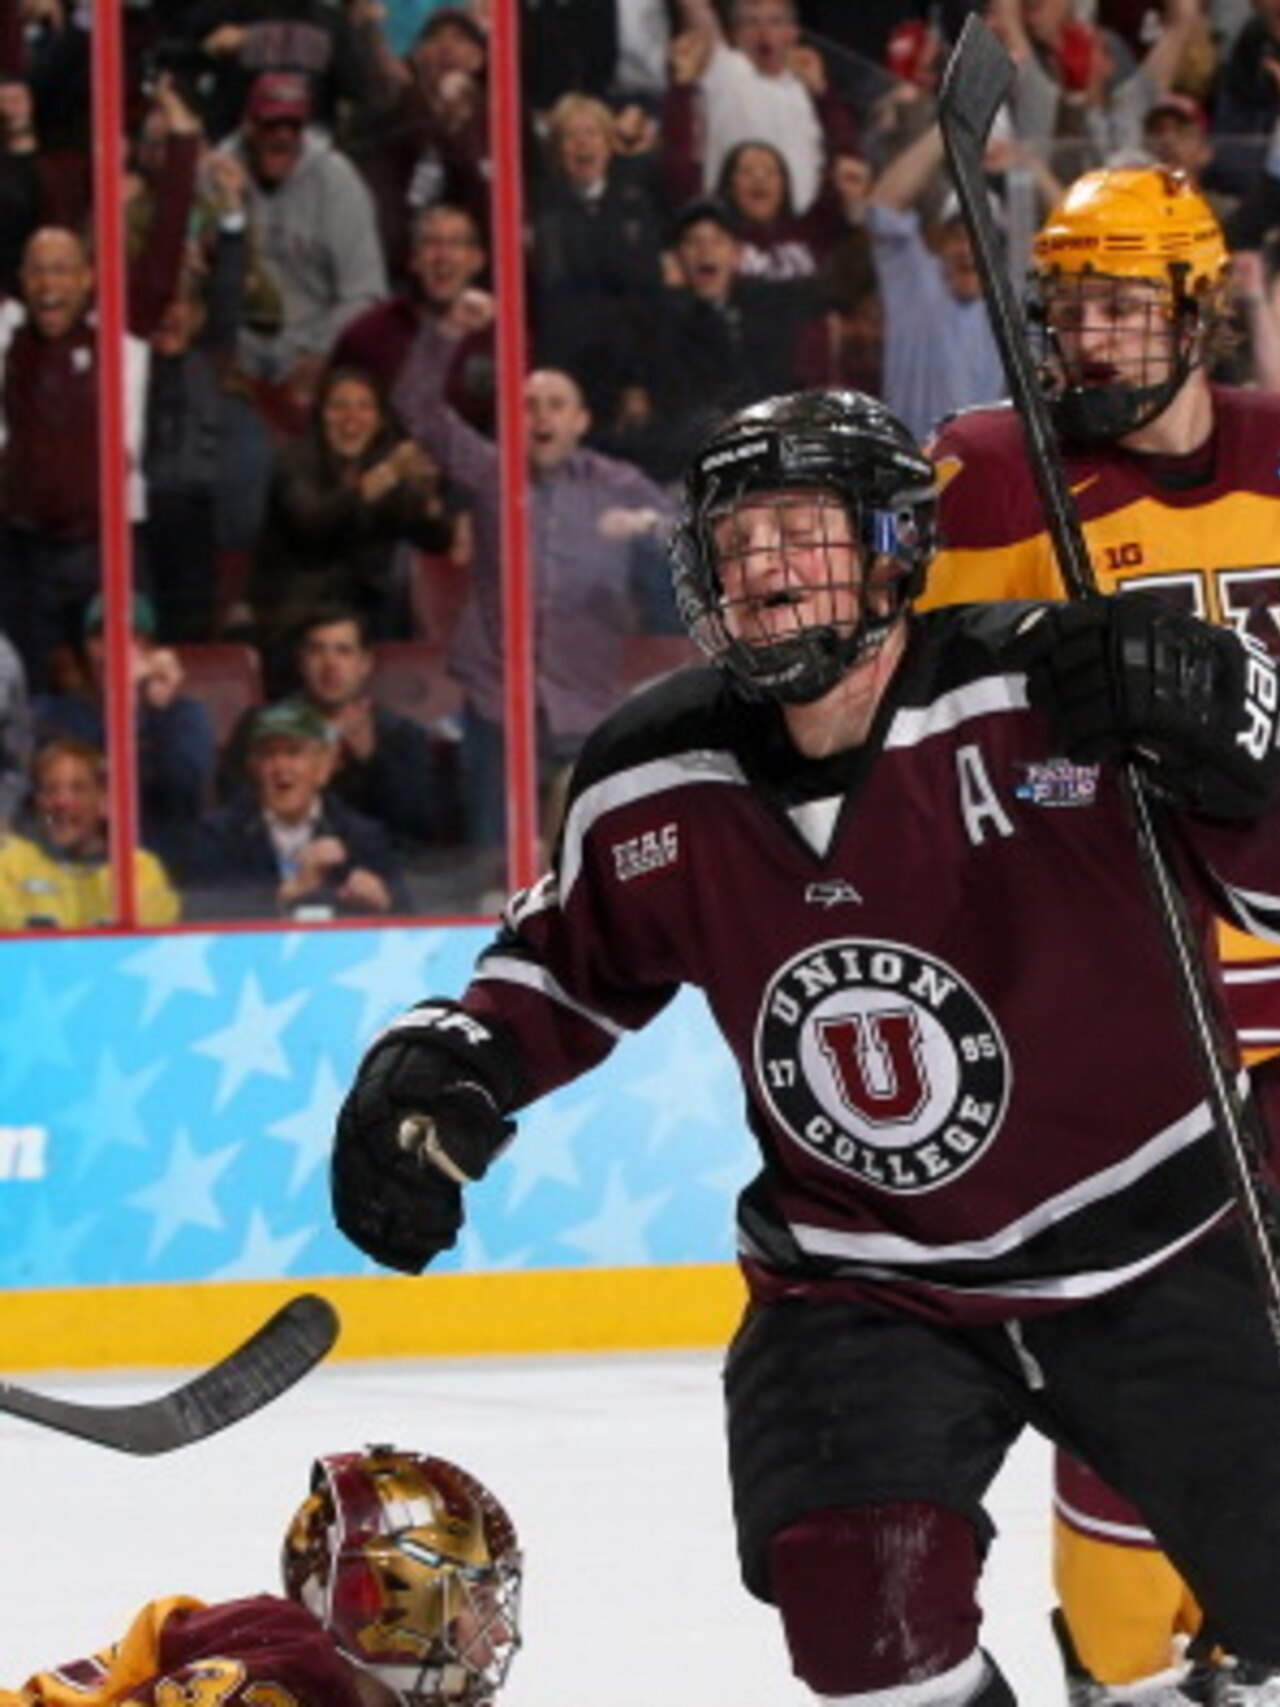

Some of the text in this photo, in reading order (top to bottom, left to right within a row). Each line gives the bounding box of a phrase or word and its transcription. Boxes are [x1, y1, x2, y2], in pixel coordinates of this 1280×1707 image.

[955, 744, 1014, 847] A
[770, 949, 958, 1027] UNION
[767, 1058, 796, 1088] 17
[814, 1004, 932, 1129] U
[804, 1094, 995, 1185] COLLEGE
